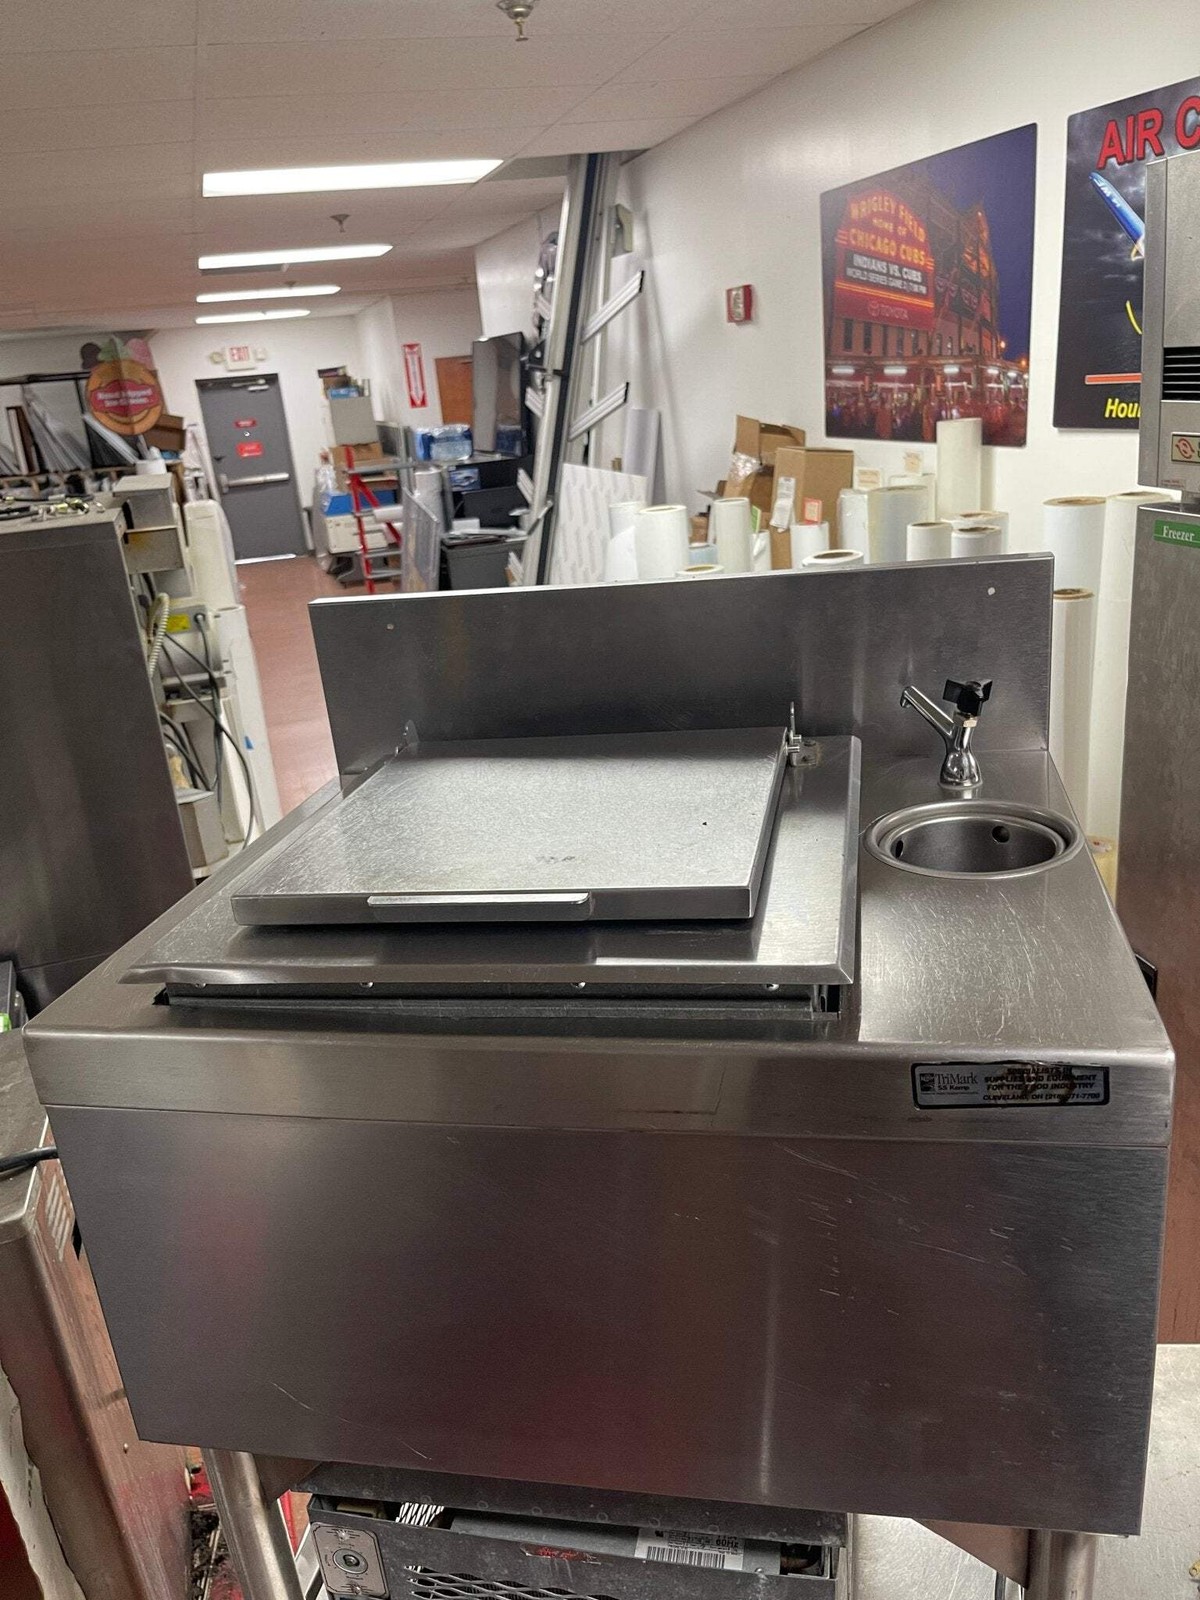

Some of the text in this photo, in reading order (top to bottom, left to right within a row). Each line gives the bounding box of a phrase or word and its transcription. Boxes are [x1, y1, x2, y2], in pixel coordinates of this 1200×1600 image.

[1096, 108, 1165, 170] AIR
[849, 196, 926, 242] WRIGLEY FIELD
[849, 228, 925, 265] CHICAGO CUBS
[853, 253, 888, 275] INDIANS
[901, 267, 922, 283] CUBS
[229, 345, 250, 362] EXIT
[1163, 525, 1195, 542] Freezer
[935, 1072, 978, 1085] TriMark
[984, 1075, 1024, 1083] SUPPLIES
